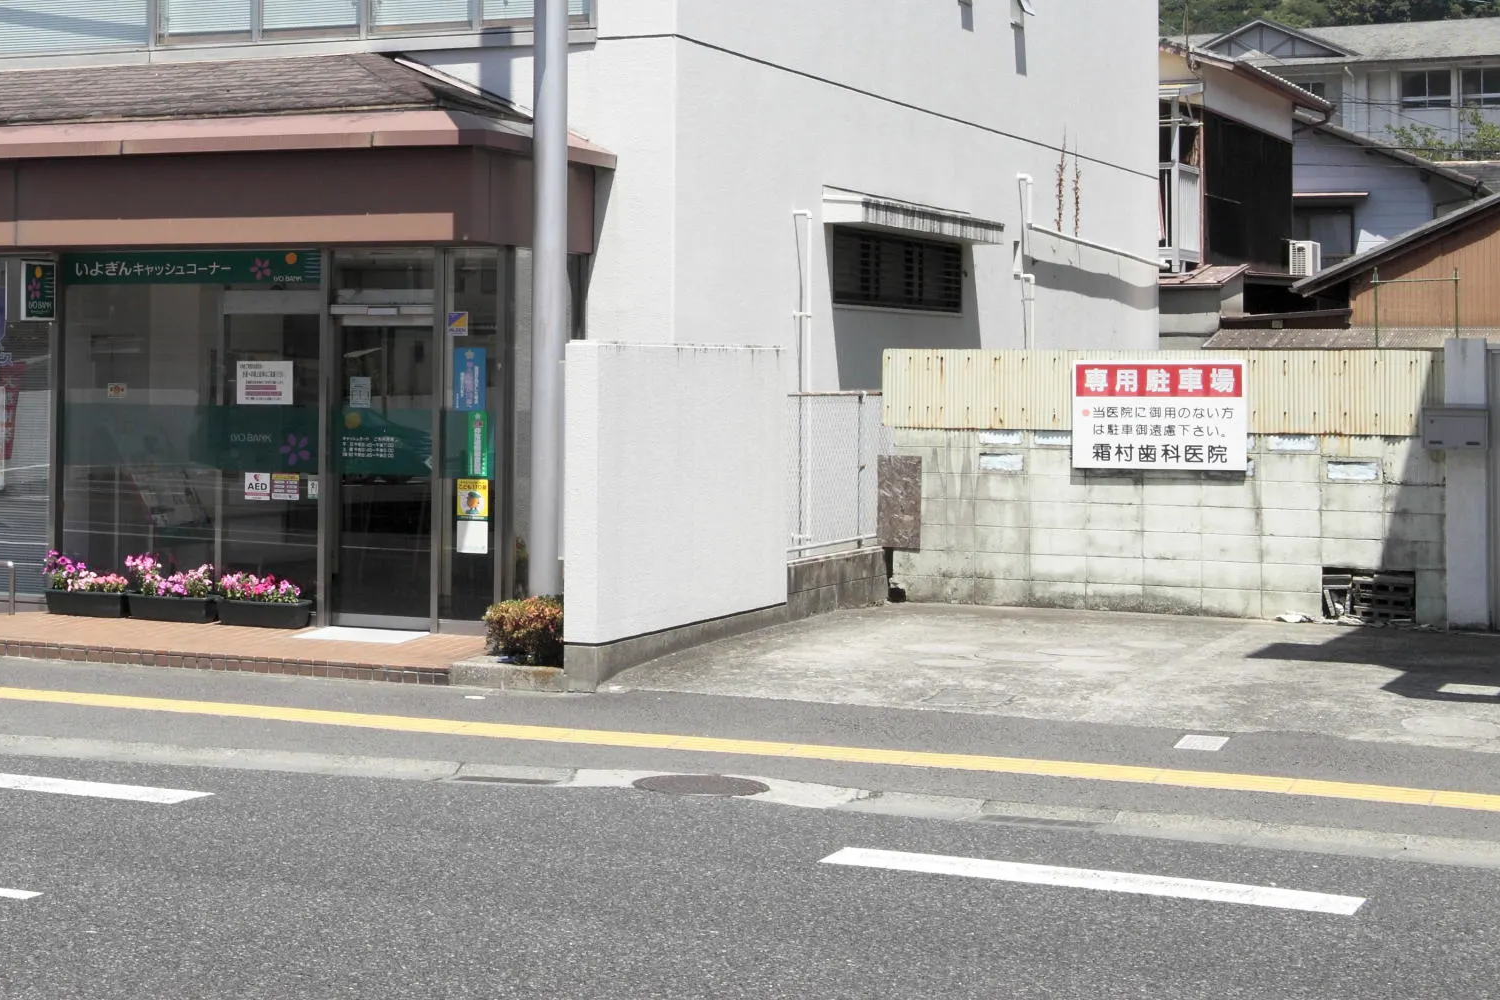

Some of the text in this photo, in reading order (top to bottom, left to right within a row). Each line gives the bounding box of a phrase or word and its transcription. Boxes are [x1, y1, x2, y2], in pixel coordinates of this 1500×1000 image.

[75, 261, 232, 277] いよぎんキャッシュコーナー
[1084, 367, 1235, 393] 専用駐車場
[1092, 406, 1235, 420] 当医院に御用のない方
[1092, 424, 1226, 438] は駐車御遠慮下さい。
[1091, 443, 1229, 464] 霜村歯科医院
[247, 482, 268, 491] AED
